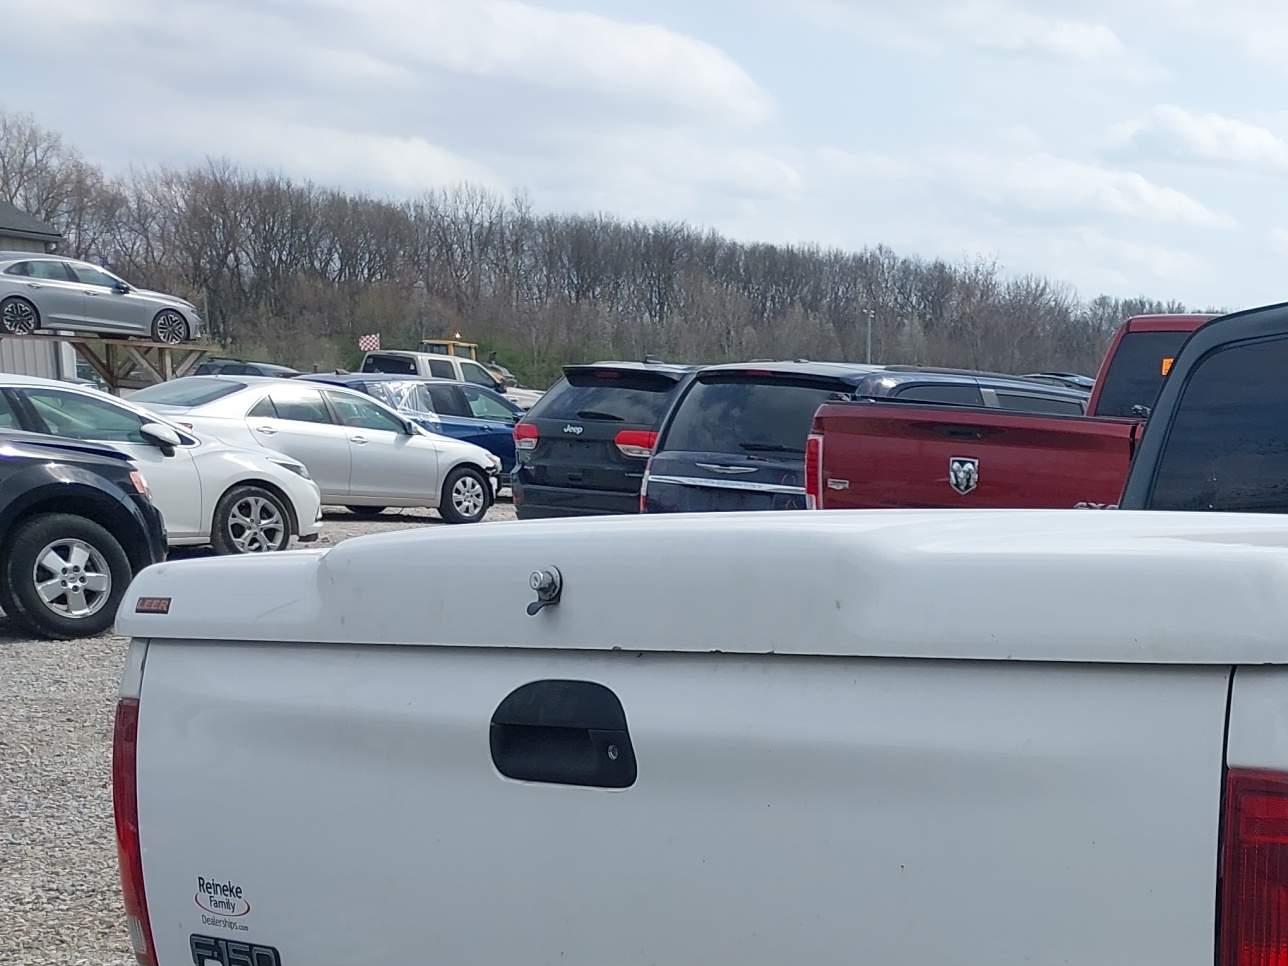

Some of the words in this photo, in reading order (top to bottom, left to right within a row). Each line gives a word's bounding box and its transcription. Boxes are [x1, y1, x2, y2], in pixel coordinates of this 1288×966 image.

[563, 423, 584, 435] Jeep
[137, 598, 170, 611] LEER
[198, 876, 243, 899] Reineke
[209, 895, 236, 913] Family
